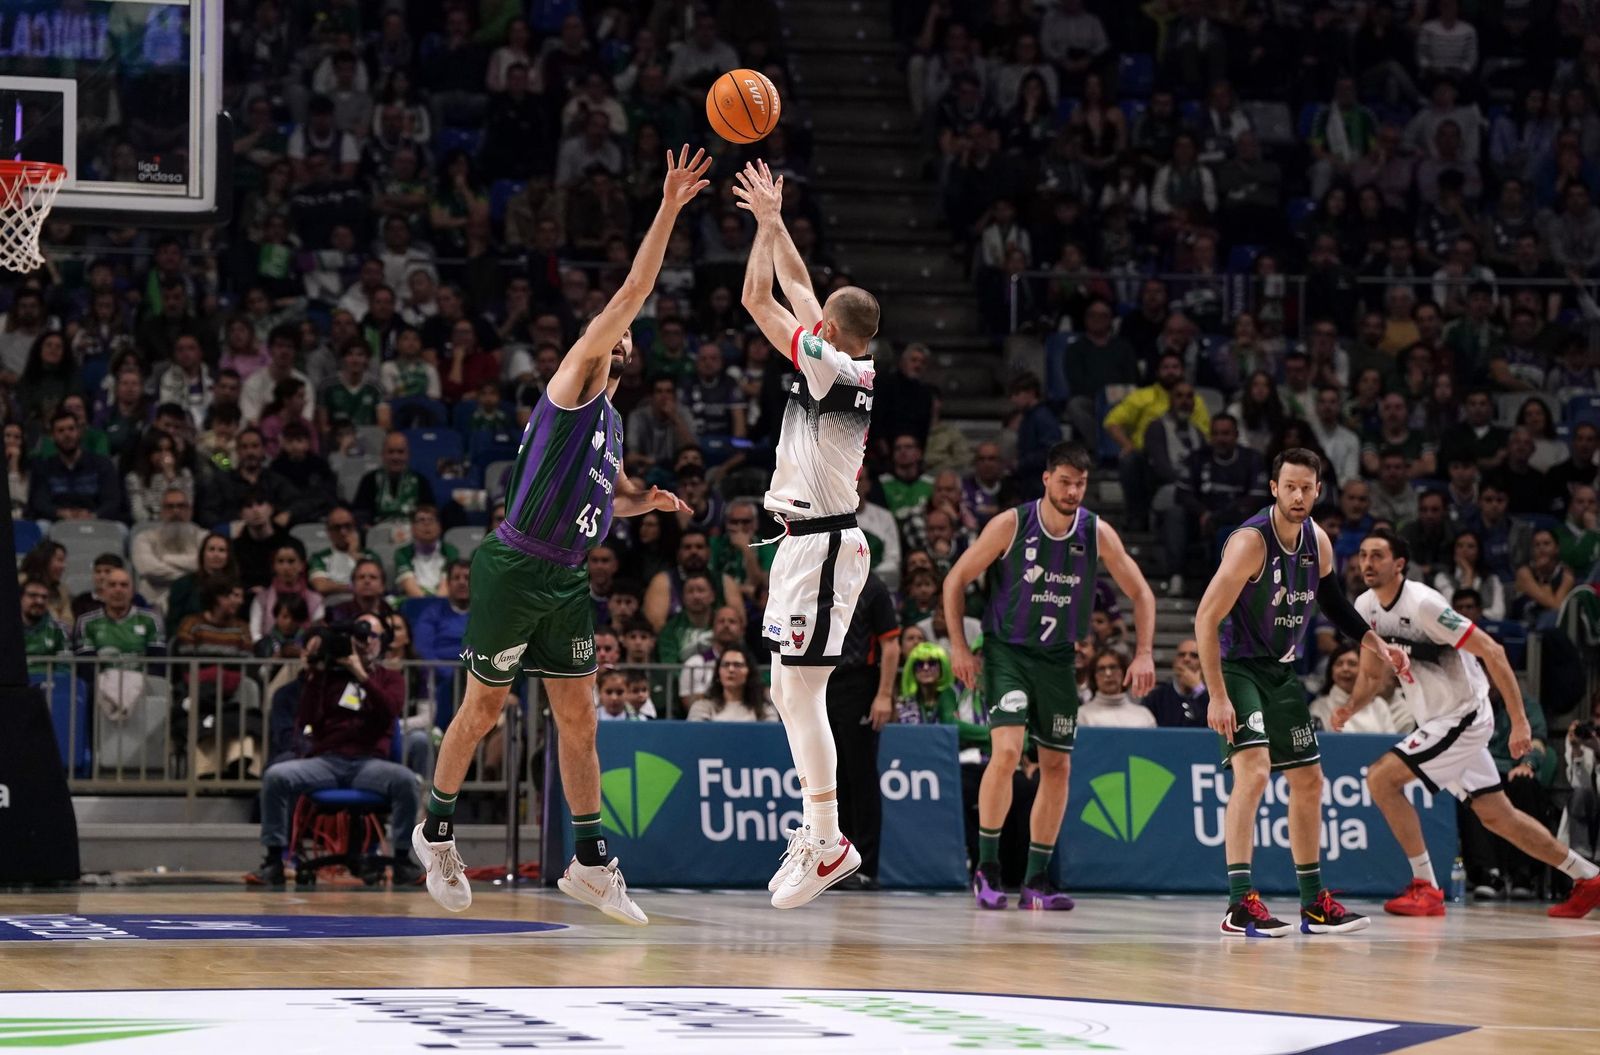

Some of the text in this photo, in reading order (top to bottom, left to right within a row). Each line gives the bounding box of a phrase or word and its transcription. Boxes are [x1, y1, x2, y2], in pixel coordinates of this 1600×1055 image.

[576, 503, 601, 538] 45
[1044, 571, 1081, 588] Unicaja
[1031, 591, 1072, 608] málaga
[1286, 589, 1315, 606] Uicaja
[1039, 615, 1057, 642] 7
[1193, 806, 1368, 861] Uicja
